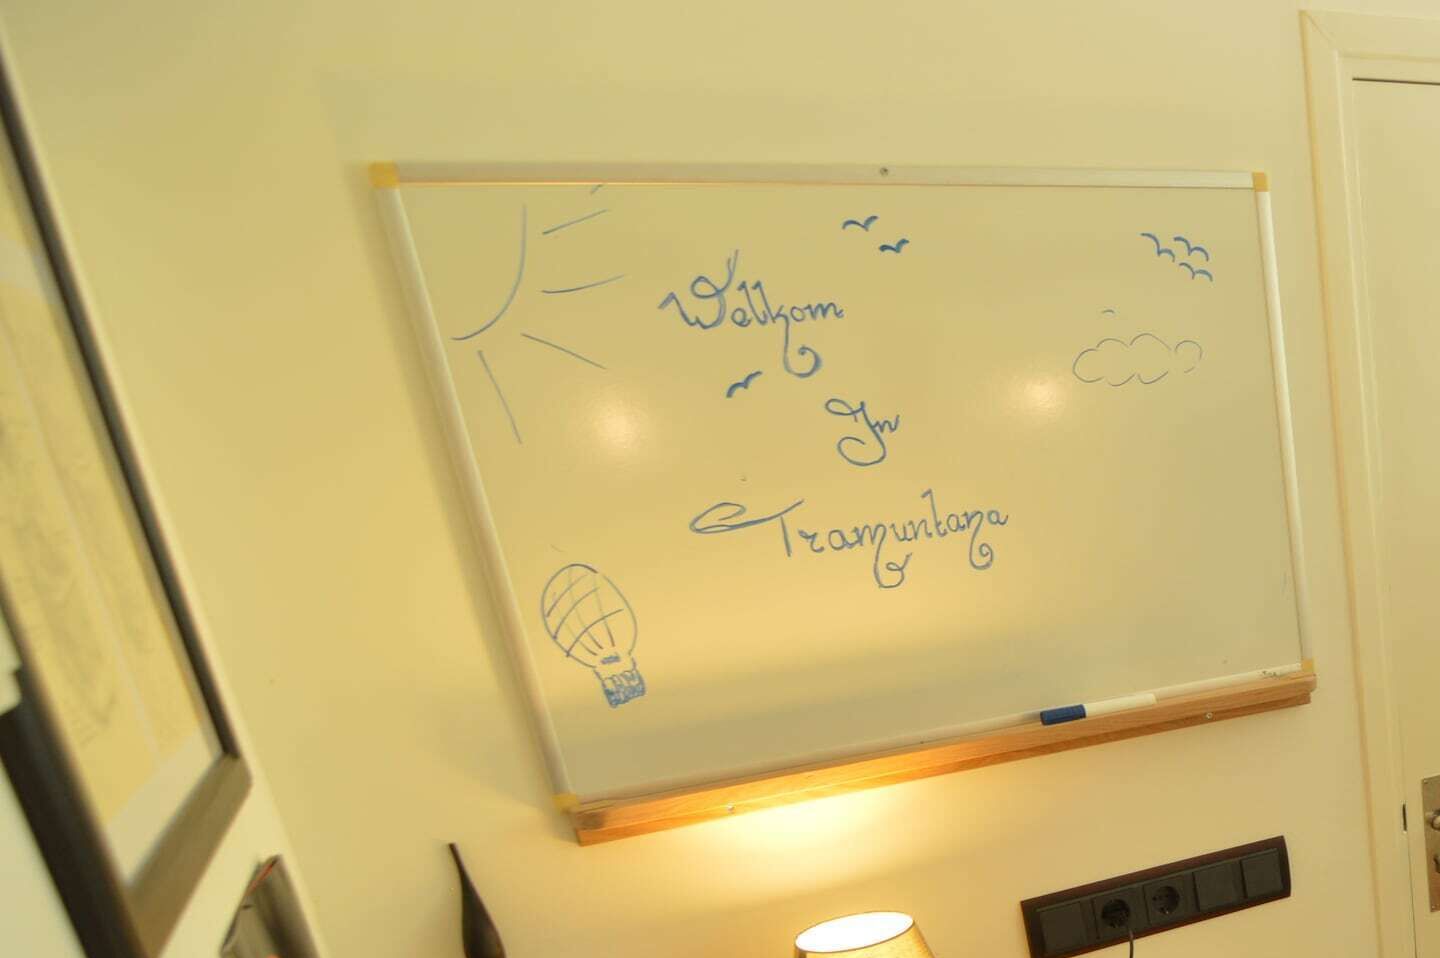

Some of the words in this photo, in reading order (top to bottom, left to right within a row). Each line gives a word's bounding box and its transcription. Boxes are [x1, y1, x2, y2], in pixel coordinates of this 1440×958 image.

[658, 249, 845, 378] Welkom
[824, 398, 901, 466] In
[689, 489, 1009, 589] Tramuntana
